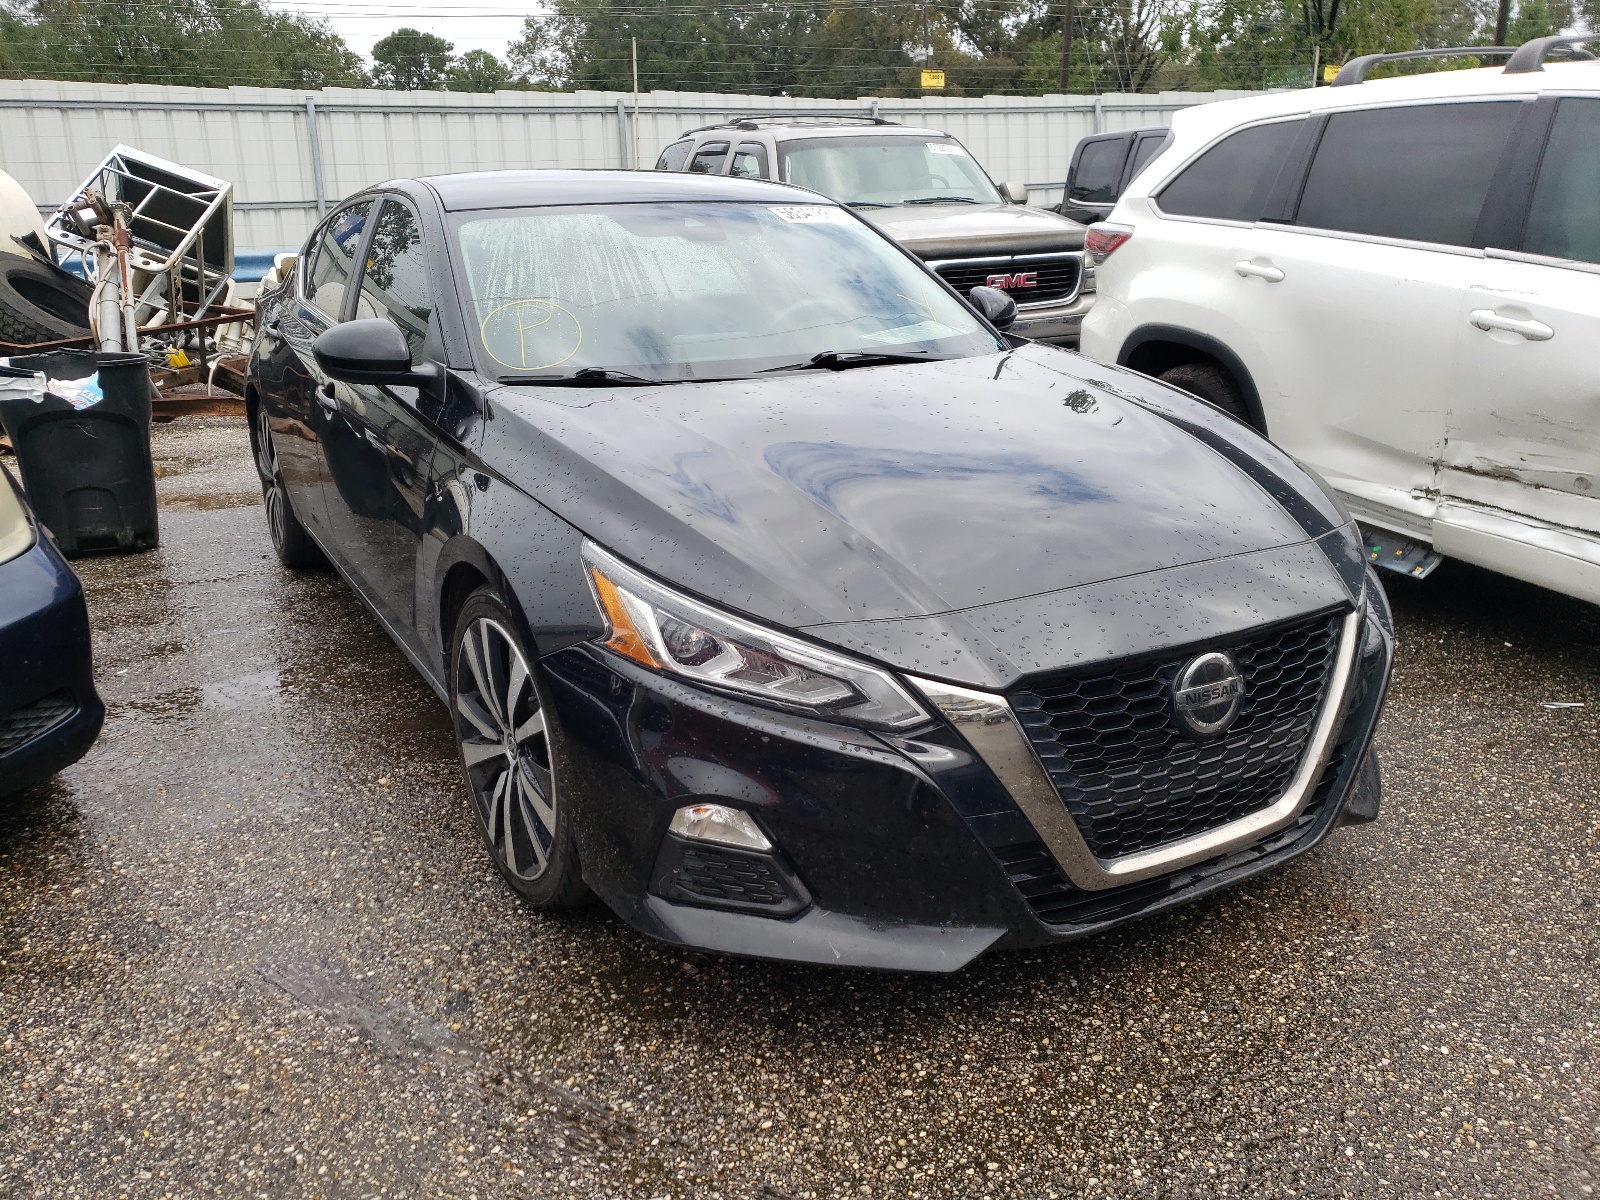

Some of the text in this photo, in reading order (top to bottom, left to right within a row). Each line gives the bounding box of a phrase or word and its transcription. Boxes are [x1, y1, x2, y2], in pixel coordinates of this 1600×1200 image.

[986, 272, 1038, 289] GMC
[516, 304, 552, 367] P
[1185, 681, 1238, 705] NISSAN
